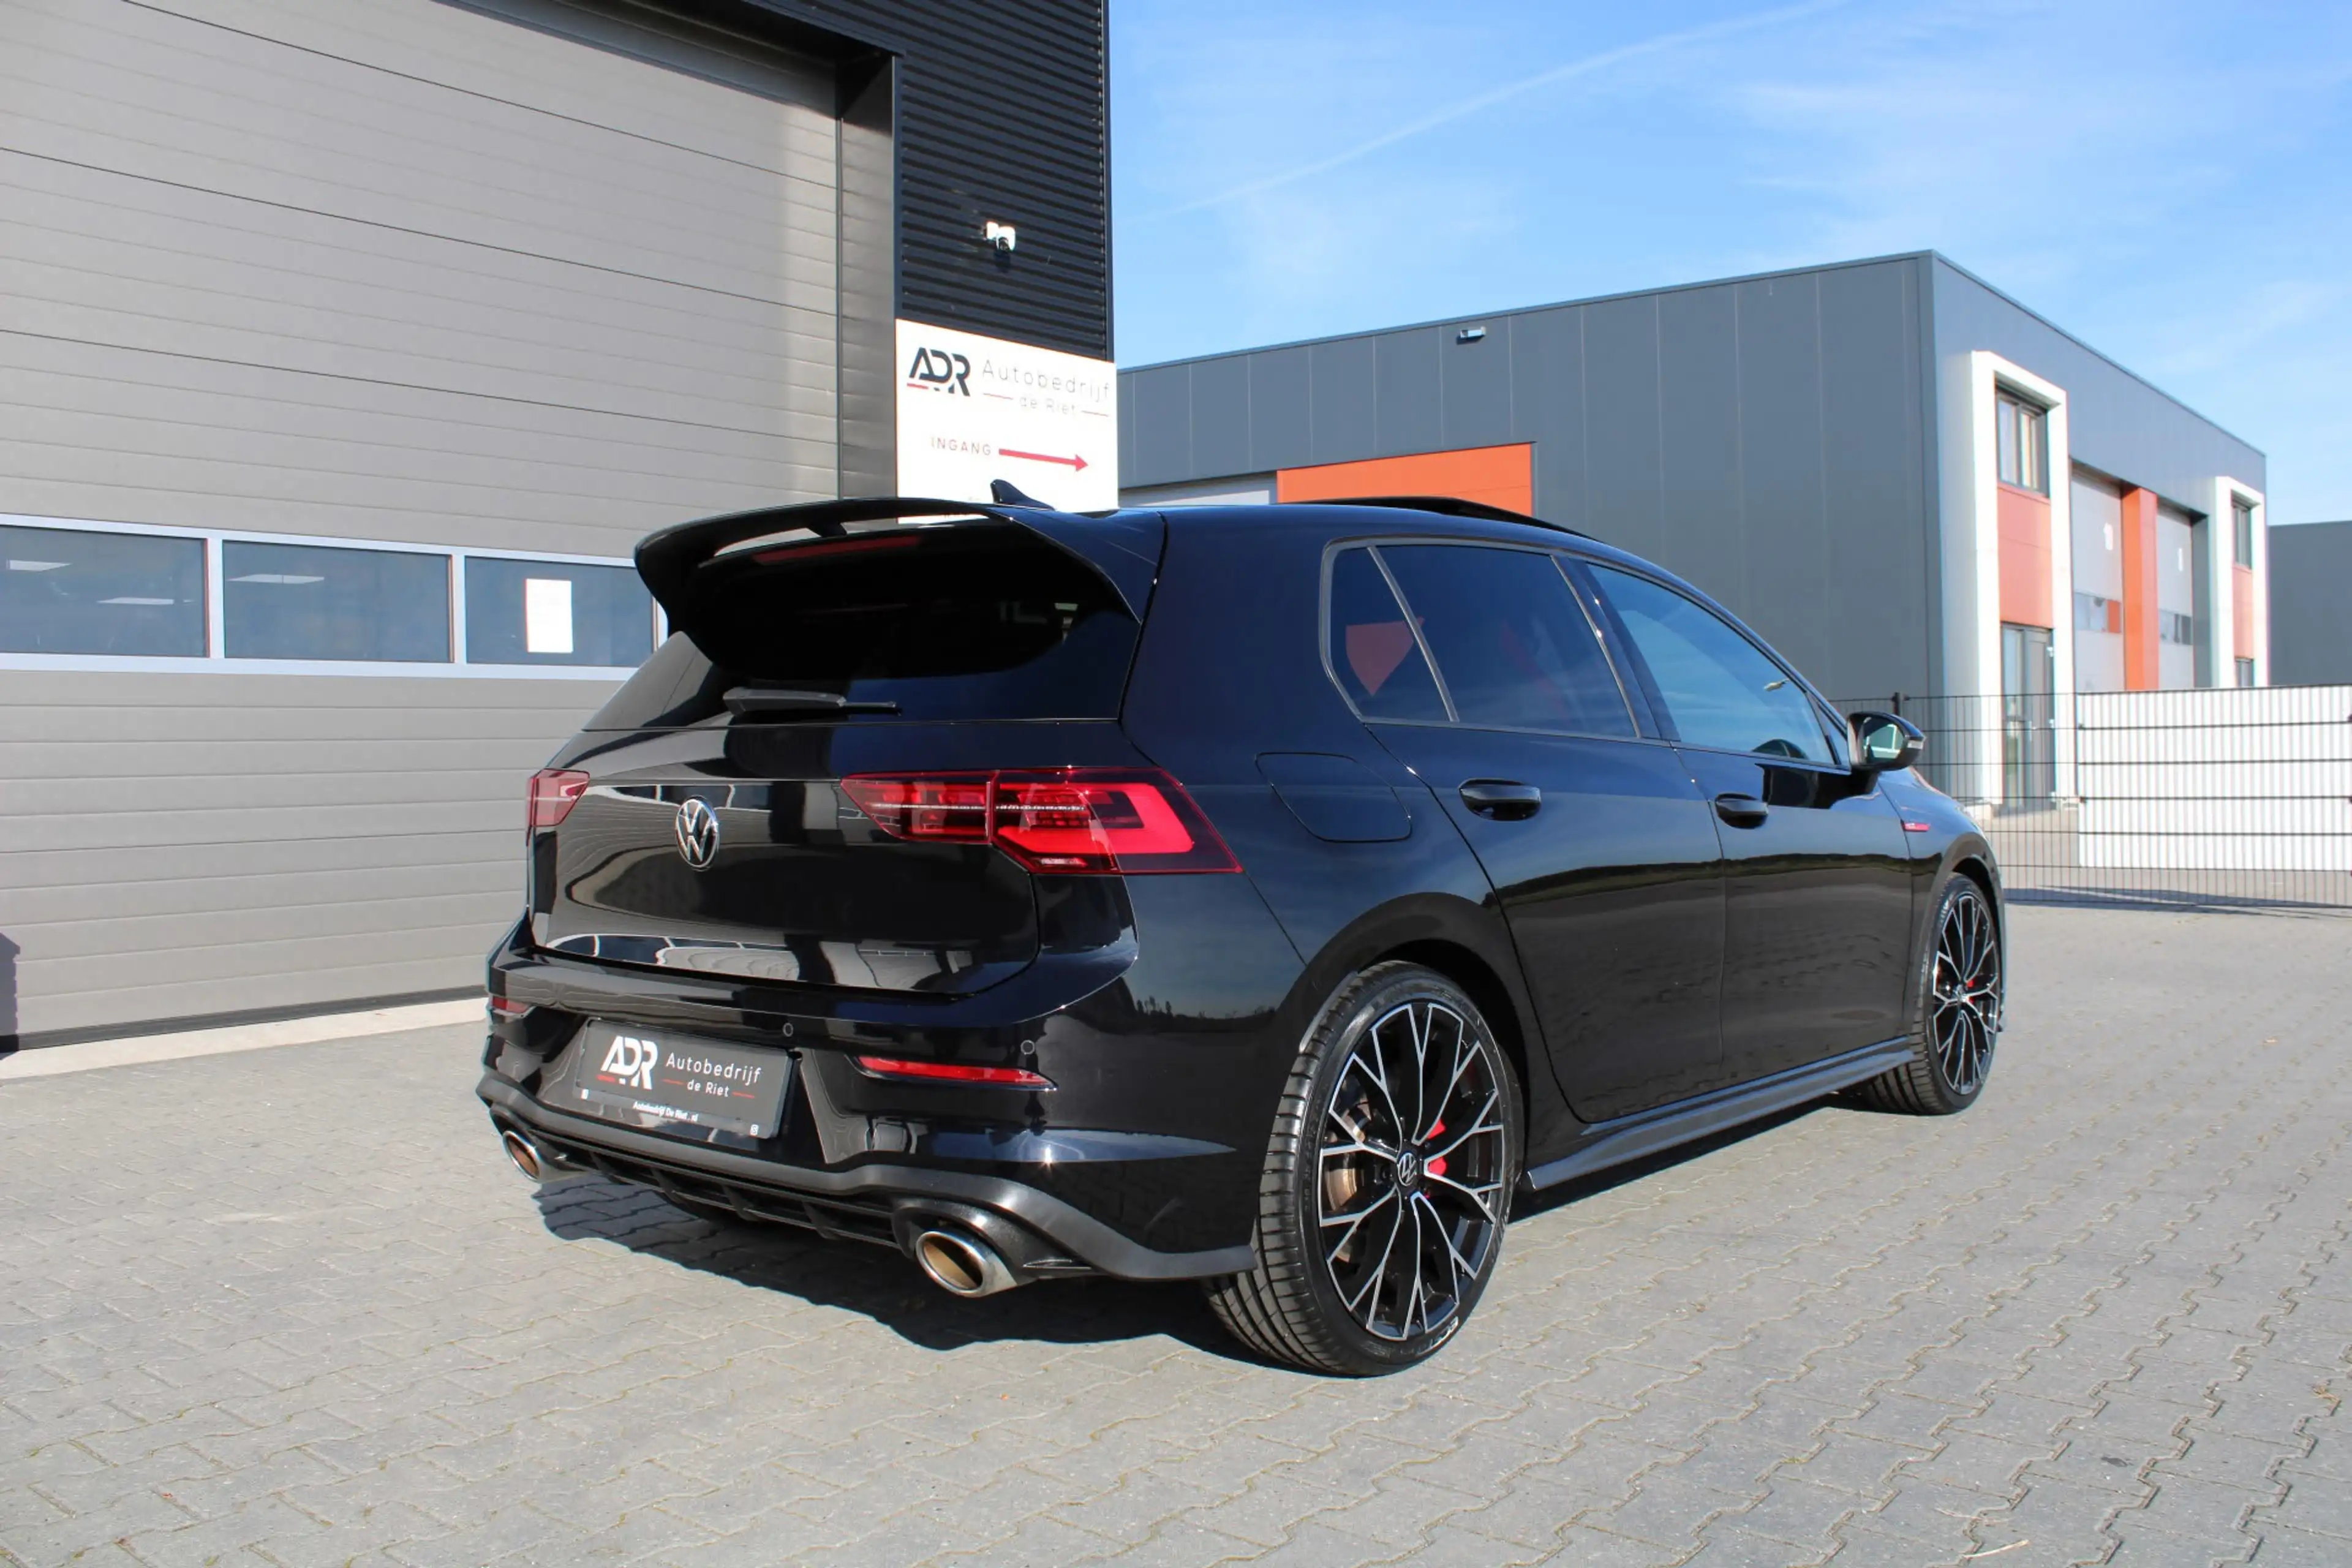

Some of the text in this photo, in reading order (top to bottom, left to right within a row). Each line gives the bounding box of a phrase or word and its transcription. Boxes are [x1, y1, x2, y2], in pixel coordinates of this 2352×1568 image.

[908, 347, 971, 396] ADR
[982, 360, 1109, 402] Autobedrijf
[1019, 396, 1076, 415] de Riet
[931, 437, 991, 456] INGANG
[600, 1036, 658, 1090] ADR
[666, 1053, 761, 1086] Autobedrijf
[687, 1079, 729, 1097] de Riet
